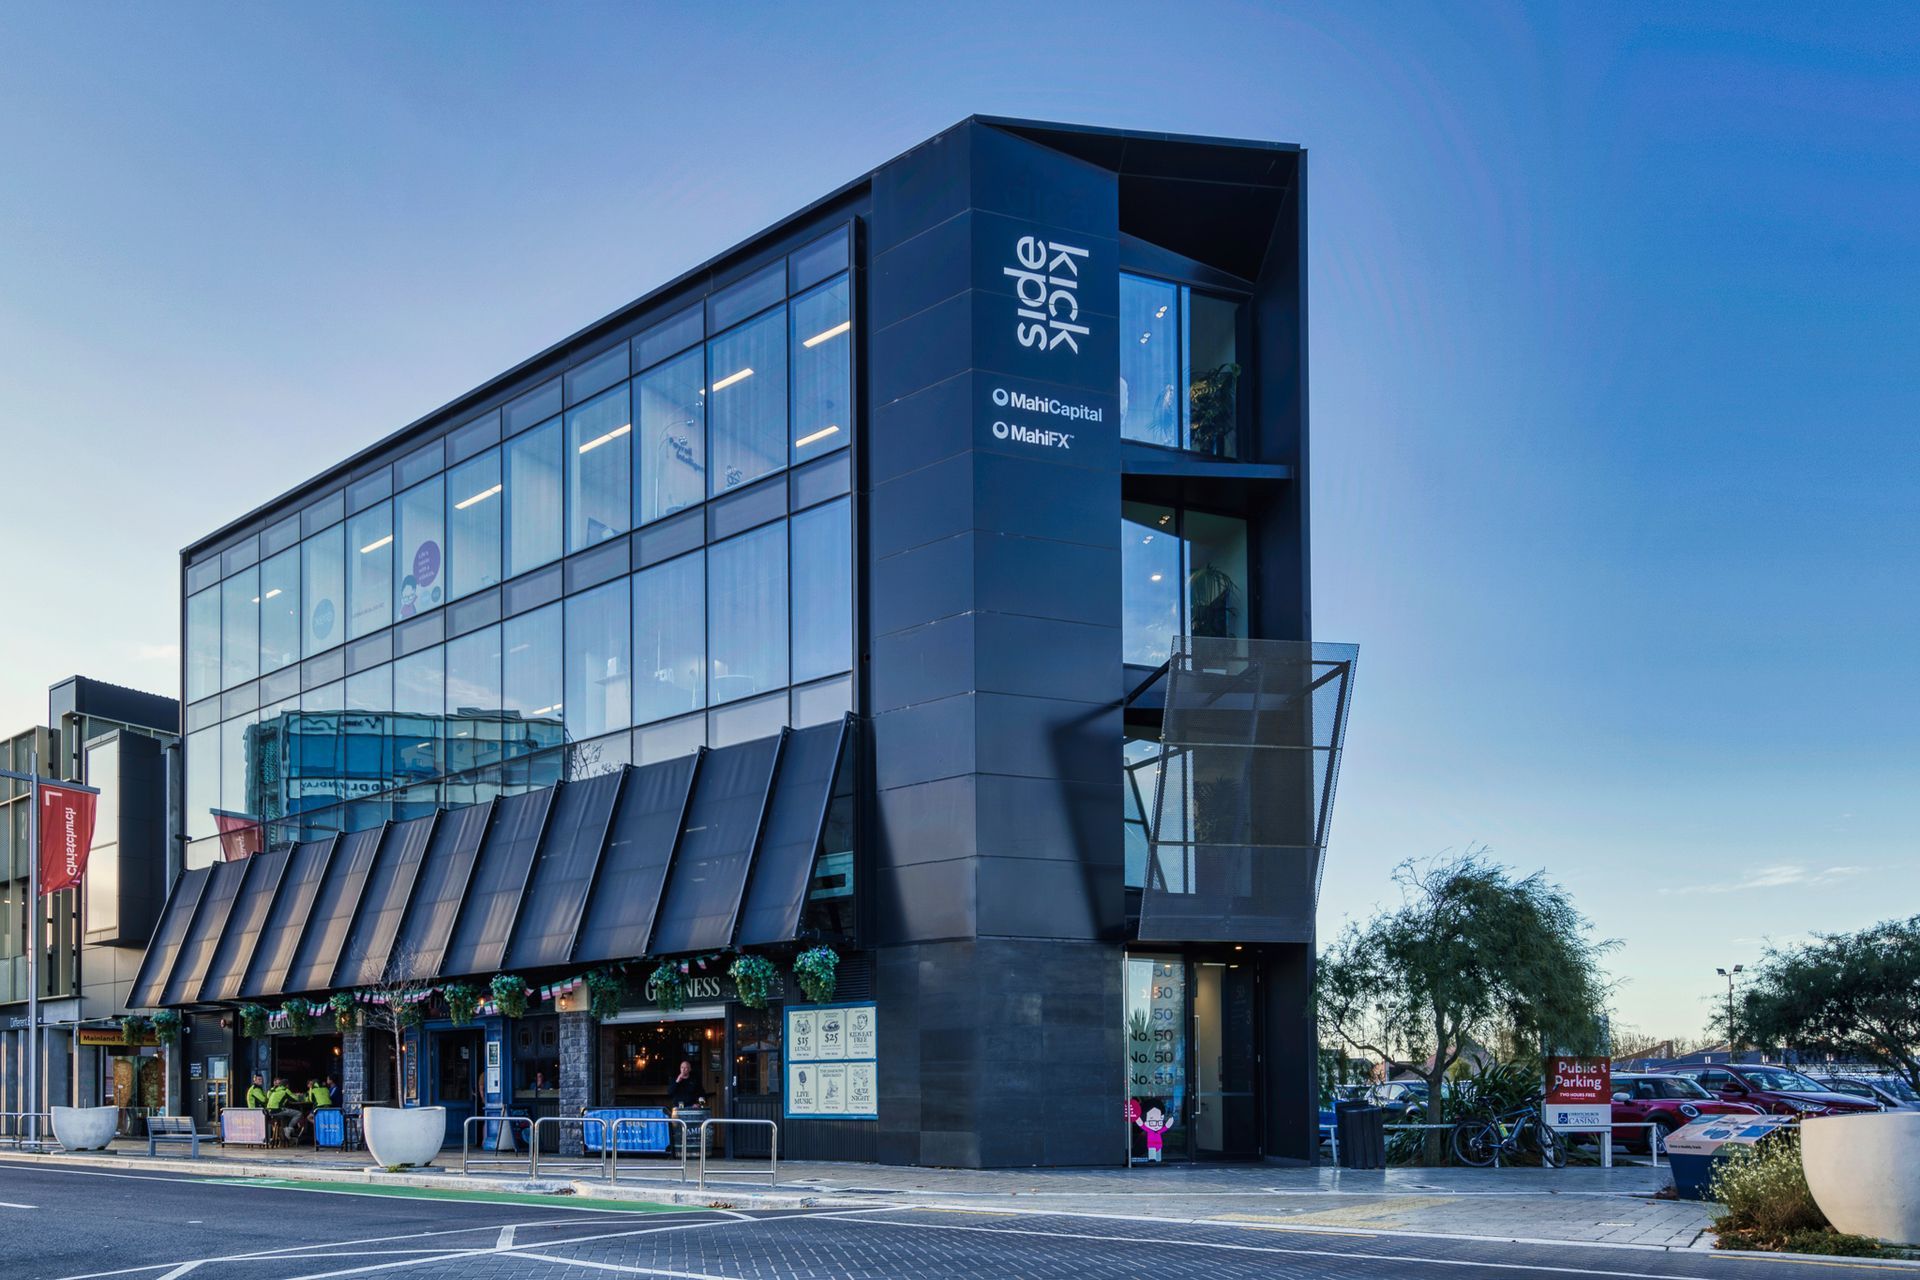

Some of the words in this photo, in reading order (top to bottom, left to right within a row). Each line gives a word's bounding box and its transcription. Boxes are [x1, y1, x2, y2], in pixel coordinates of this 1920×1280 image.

[1048, 241, 1090, 355] kick
[1010, 391, 1103, 422] MahiCapital
[645, 976, 720, 1001] GNESS
[1154, 1008, 1173, 1020] 50
[825, 1033, 839, 1043] $25
[1154, 1029, 1174, 1041] 50
[797, 1037, 808, 1047] $15
[1154, 1051, 1174, 1063] 50
[1558, 1061, 1597, 1073] Public
[1154, 1073, 1174, 1085] 50
[1555, 1074, 1602, 1090] Parking
